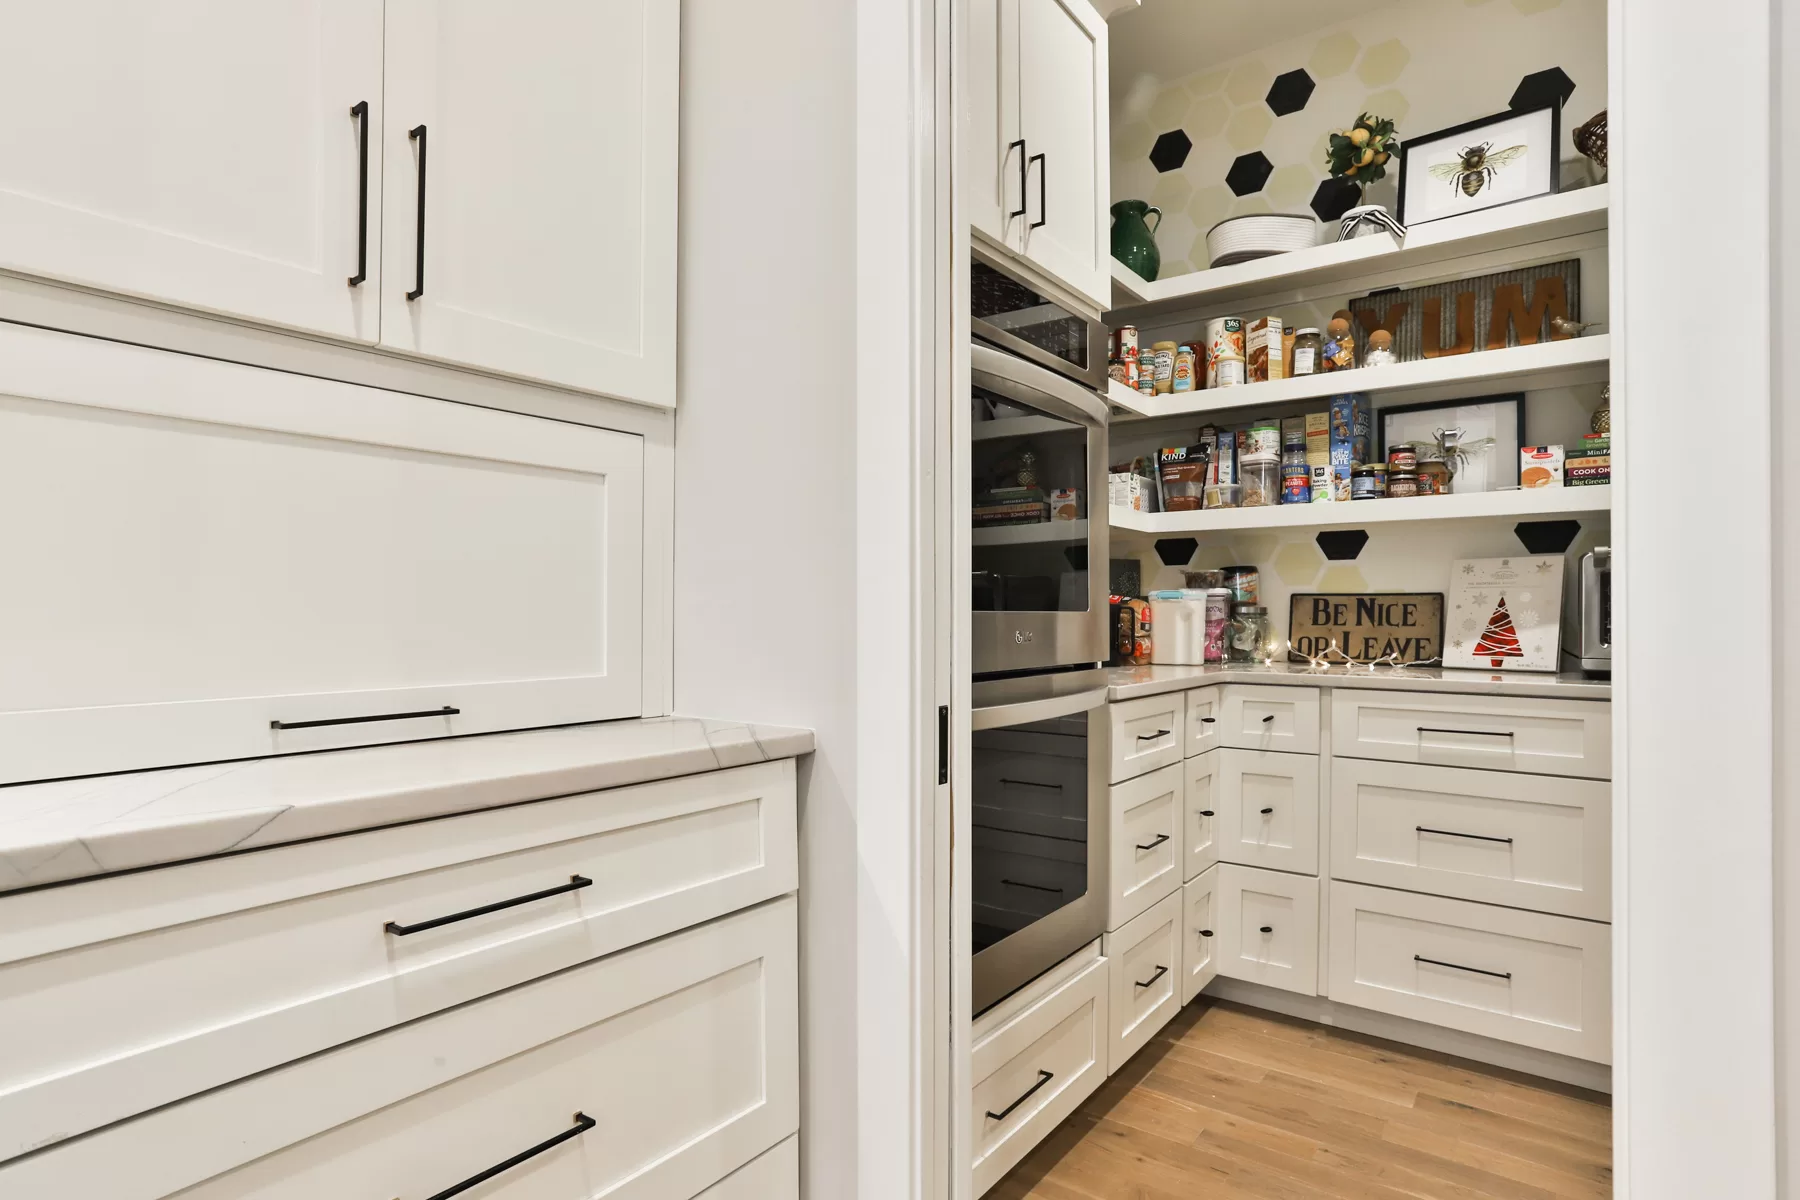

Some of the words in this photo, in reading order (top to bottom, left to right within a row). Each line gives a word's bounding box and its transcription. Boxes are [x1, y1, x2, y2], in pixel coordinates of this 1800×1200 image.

[1226, 320, 1240, 328] 365
[1358, 275, 1572, 359] YUM
[1358, 412, 1369, 426] RICE
[1161, 453, 1186, 461] KIND
[1311, 597, 1348, 626] BE
[1355, 597, 1418, 628] NICE
[1297, 636, 1330, 659] OR
[1342, 631, 1431, 661] LEAVE
